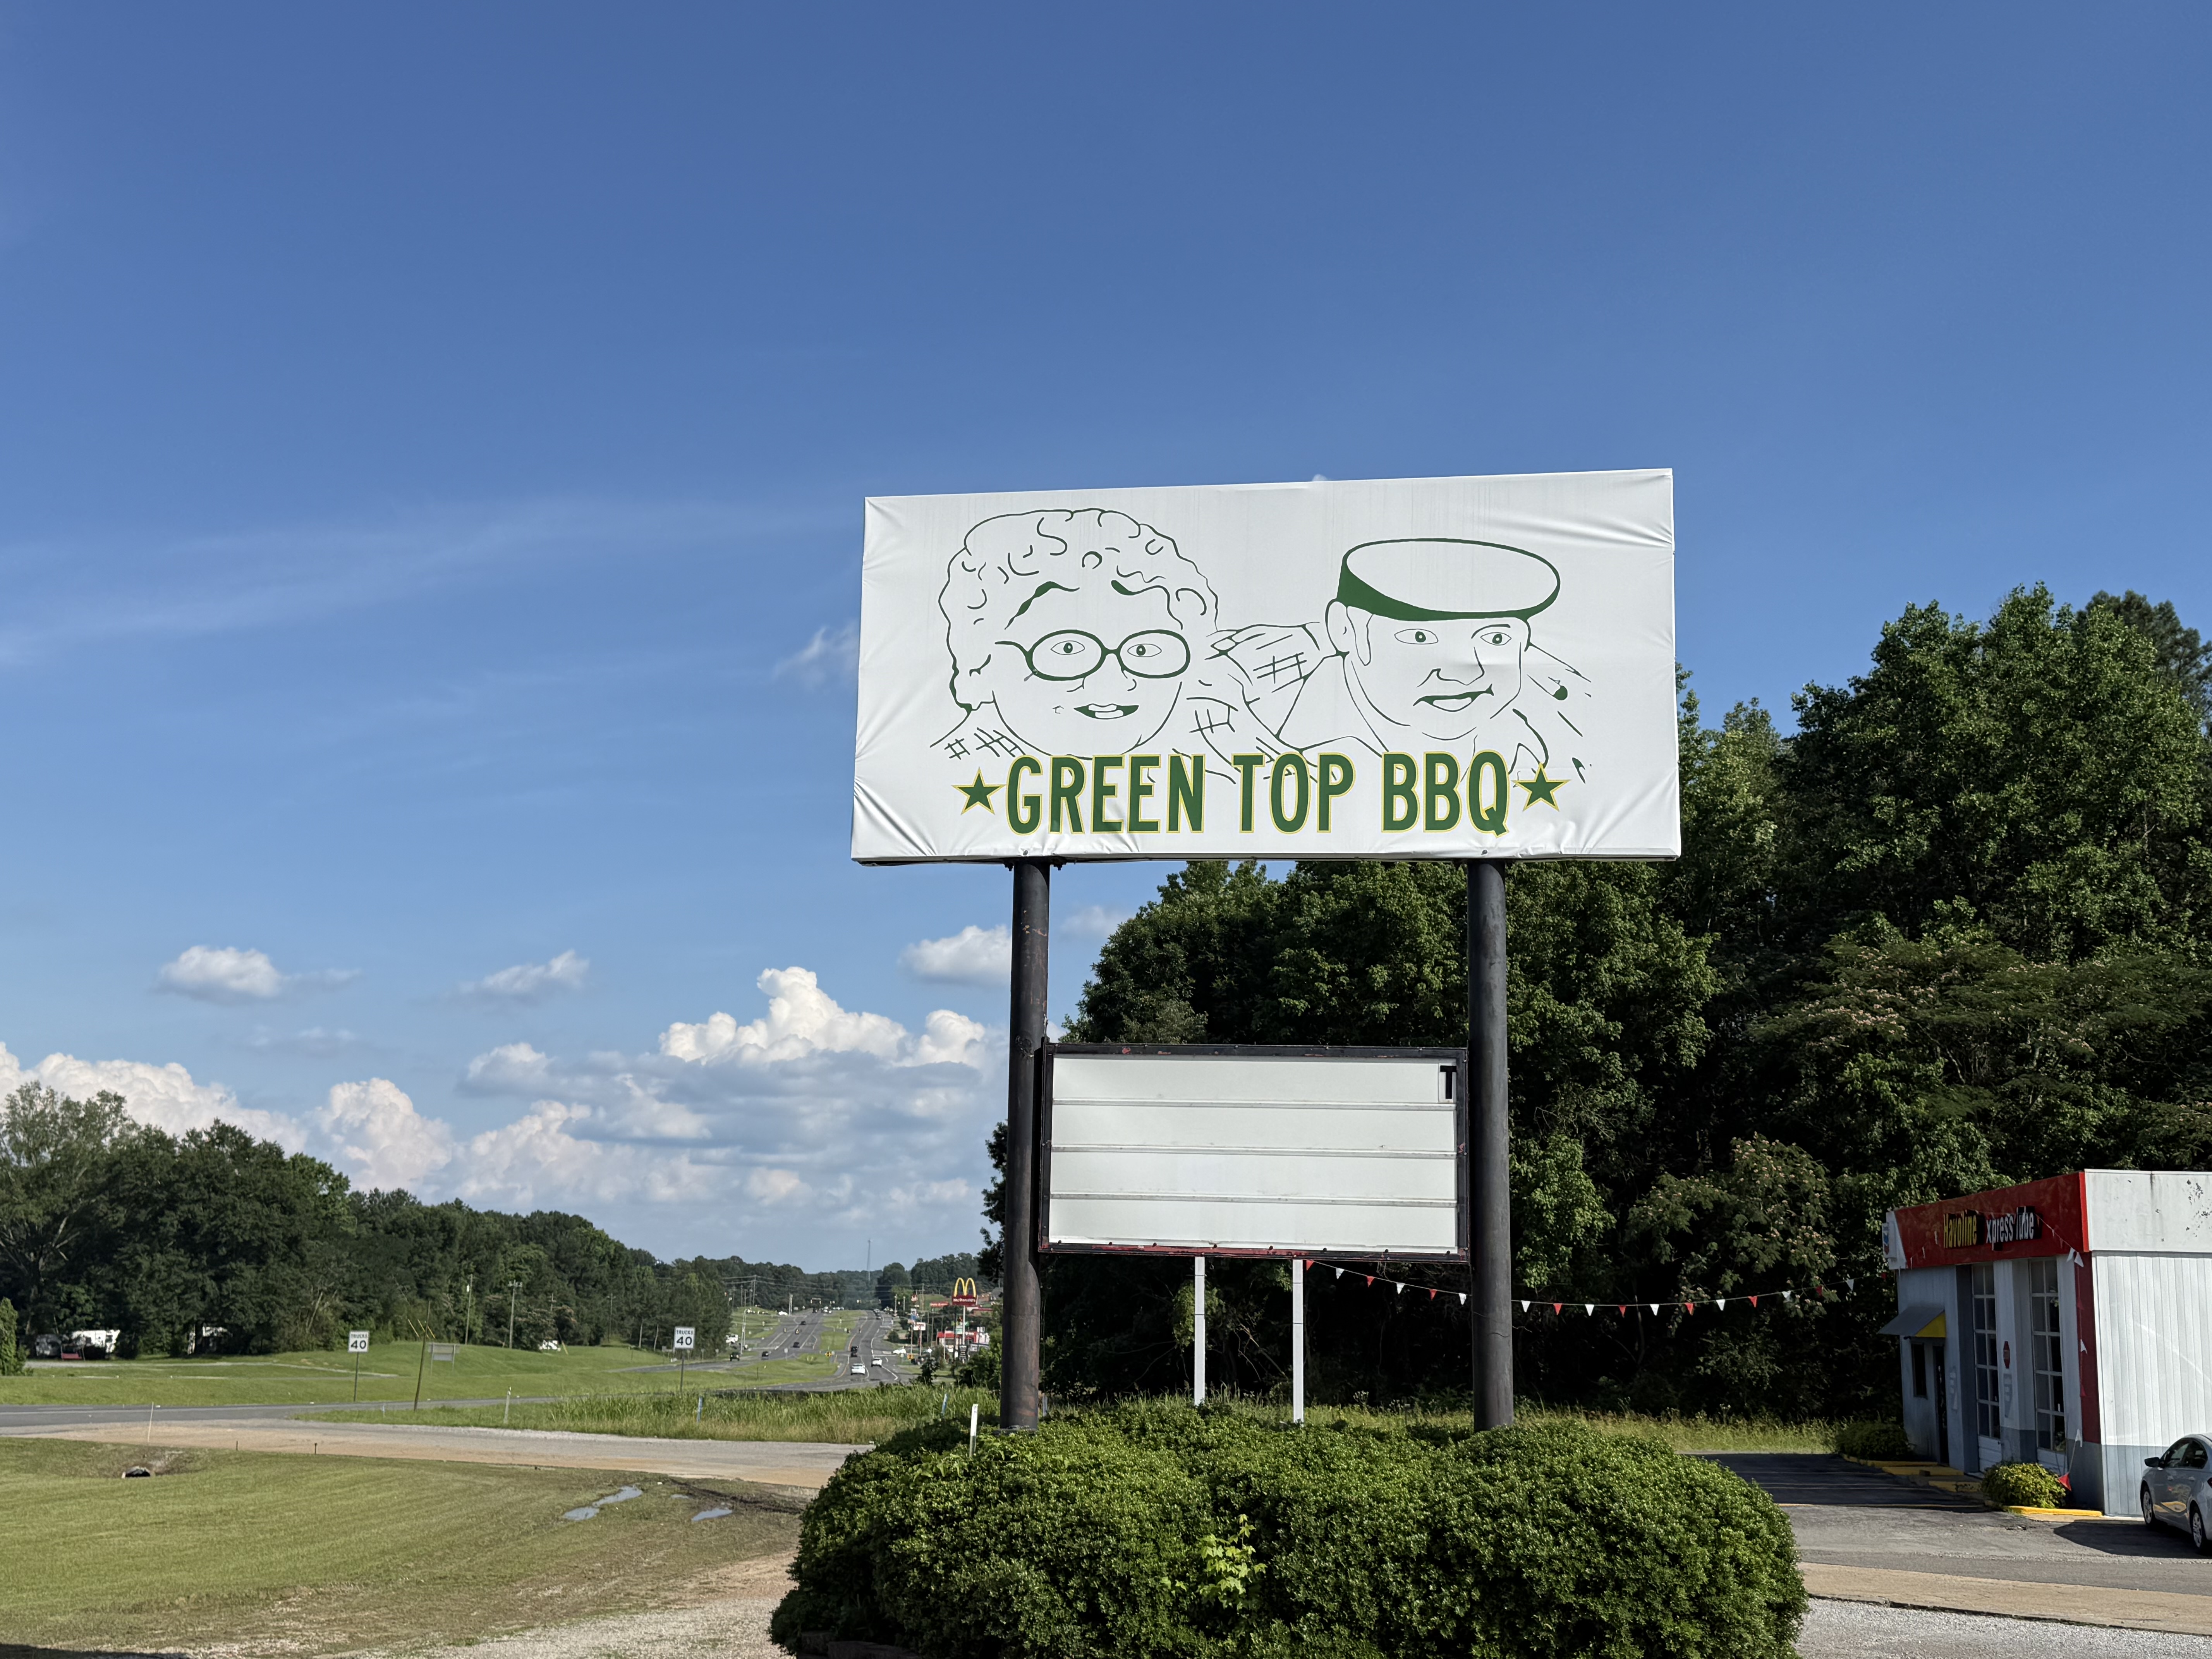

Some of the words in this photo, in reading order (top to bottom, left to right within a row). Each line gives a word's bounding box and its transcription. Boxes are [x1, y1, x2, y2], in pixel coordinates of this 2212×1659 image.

[1006, 754, 1206, 835] GREEN
[1231, 752, 1356, 834] TOP
[1381, 749, 1510, 838] BBQ
[1440, 1065, 1457, 1099] T
[1943, 1210, 1977, 1249] Havoline
[1986, 1216, 2014, 1251] xpress
[2016, 1206, 2034, 1240] lube
[350, 1340, 366, 1349] 40
[677, 1336, 692, 1346] 40
